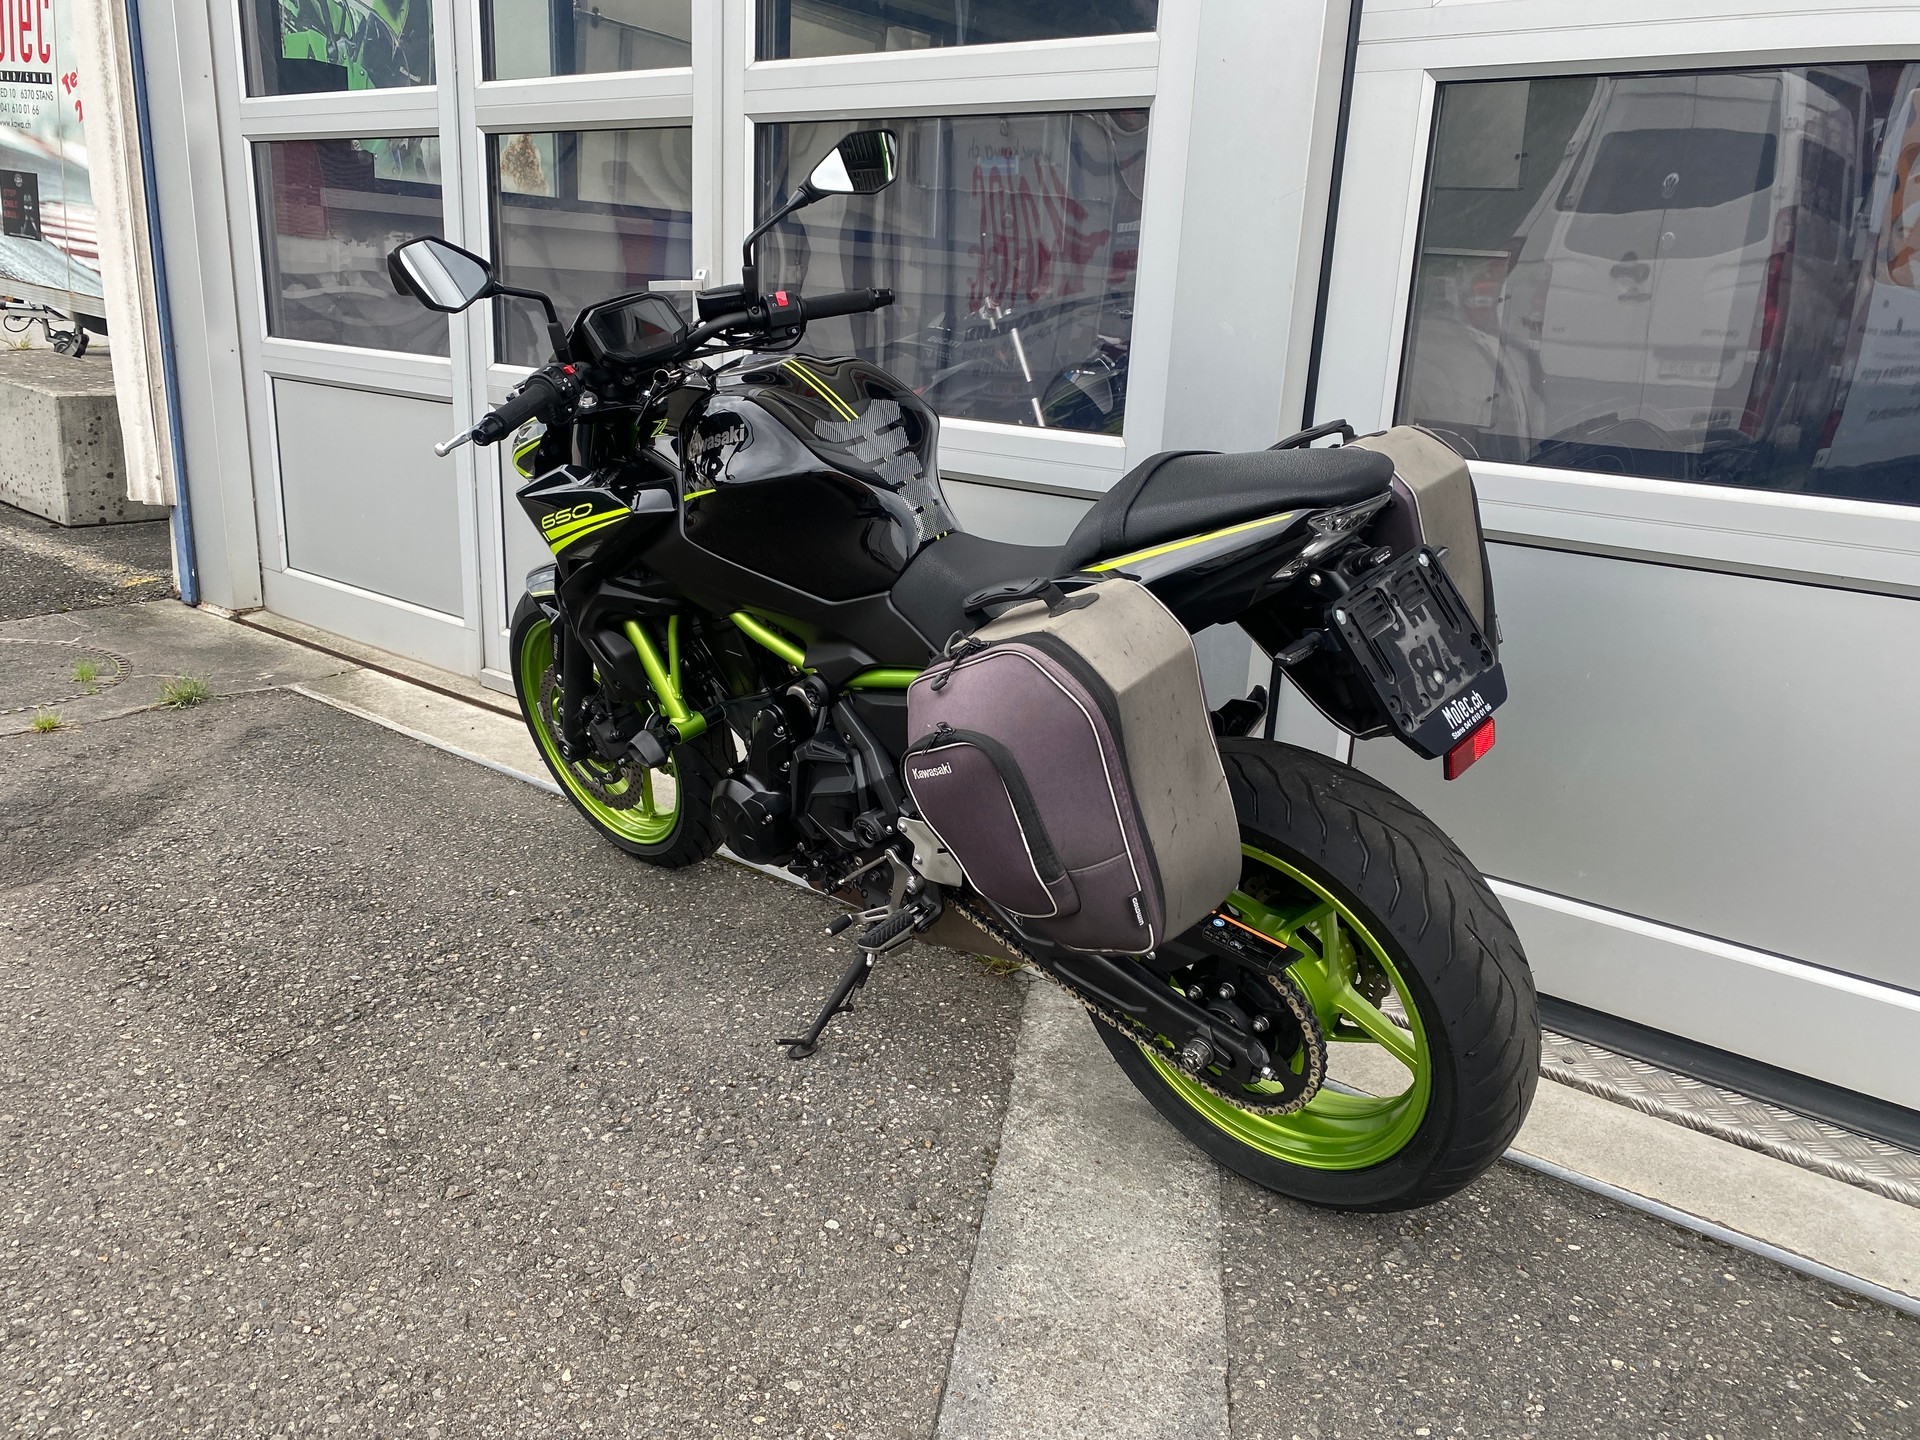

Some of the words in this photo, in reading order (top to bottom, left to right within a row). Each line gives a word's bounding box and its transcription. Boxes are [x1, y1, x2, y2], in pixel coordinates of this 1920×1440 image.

[62, 67, 78, 95] Te
[21, 89, 34, 99] 6370
[36, 90, 53, 101] STANS
[12, 103, 22, 114] 610
[32, 105, 40, 115] 66
[541, 502, 593, 530] 650
[1451, 726, 1466, 740] Stans
[911, 761, 953, 780] Kawasaki
